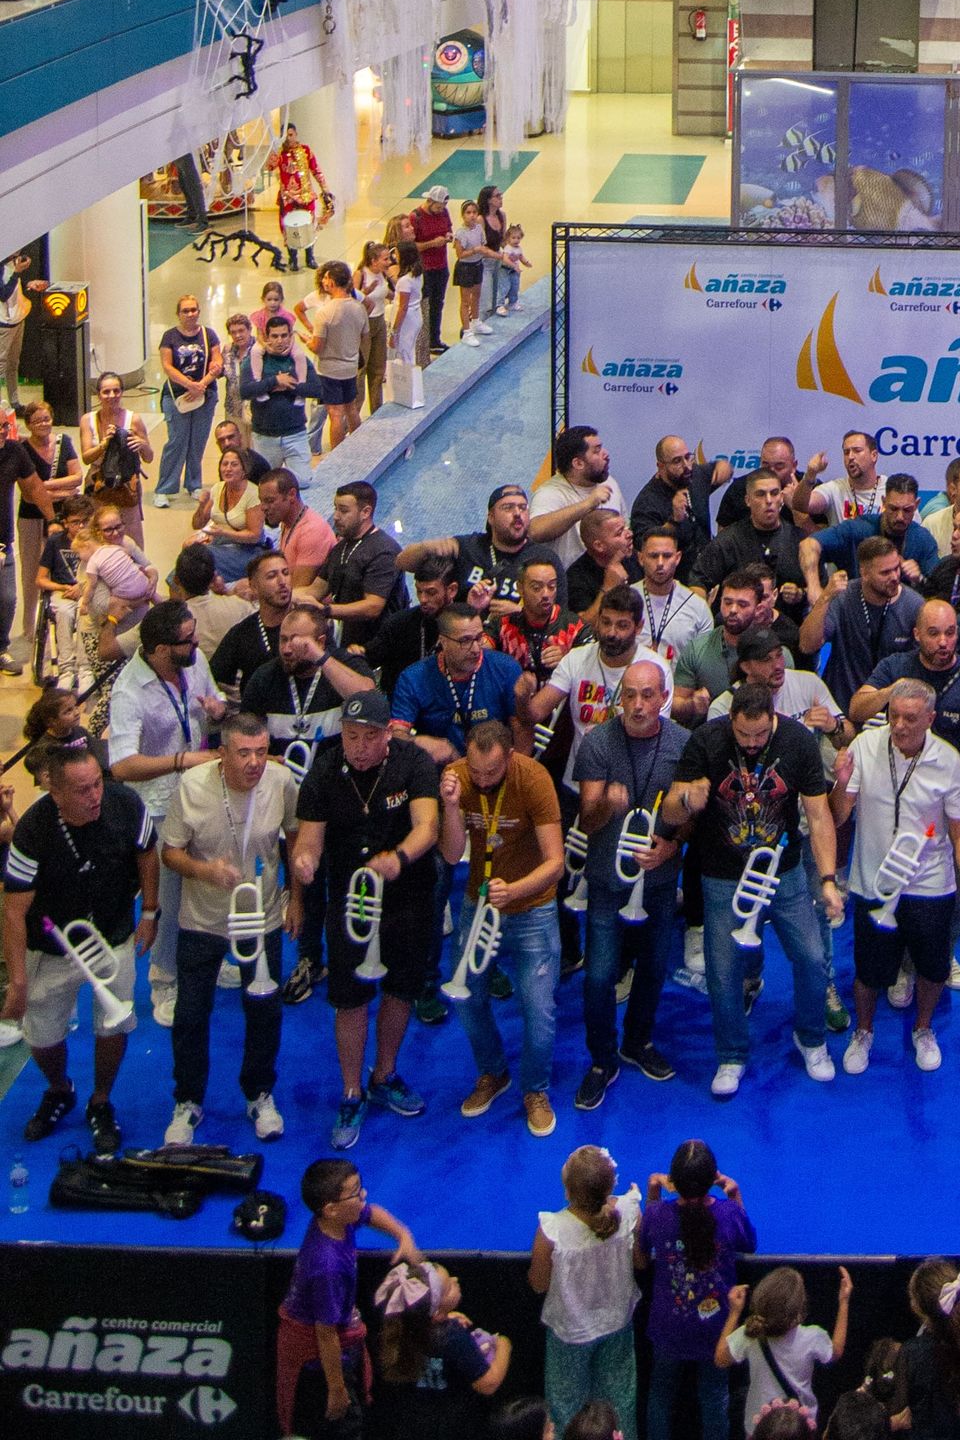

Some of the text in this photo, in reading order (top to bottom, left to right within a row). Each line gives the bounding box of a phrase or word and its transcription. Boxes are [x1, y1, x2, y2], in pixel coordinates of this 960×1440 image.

[705, 273, 787, 294] añaza
[706, 298, 758, 309] Carrefour
[890, 302, 941, 313] Carrefour
[602, 358, 683, 379] añaza
[603, 382, 655, 393] Carrefour
[101, 1317, 223, 1333] centro comercial
[1, 1316, 233, 1378] añaza
[23, 1383, 167, 1414] Carrefour
